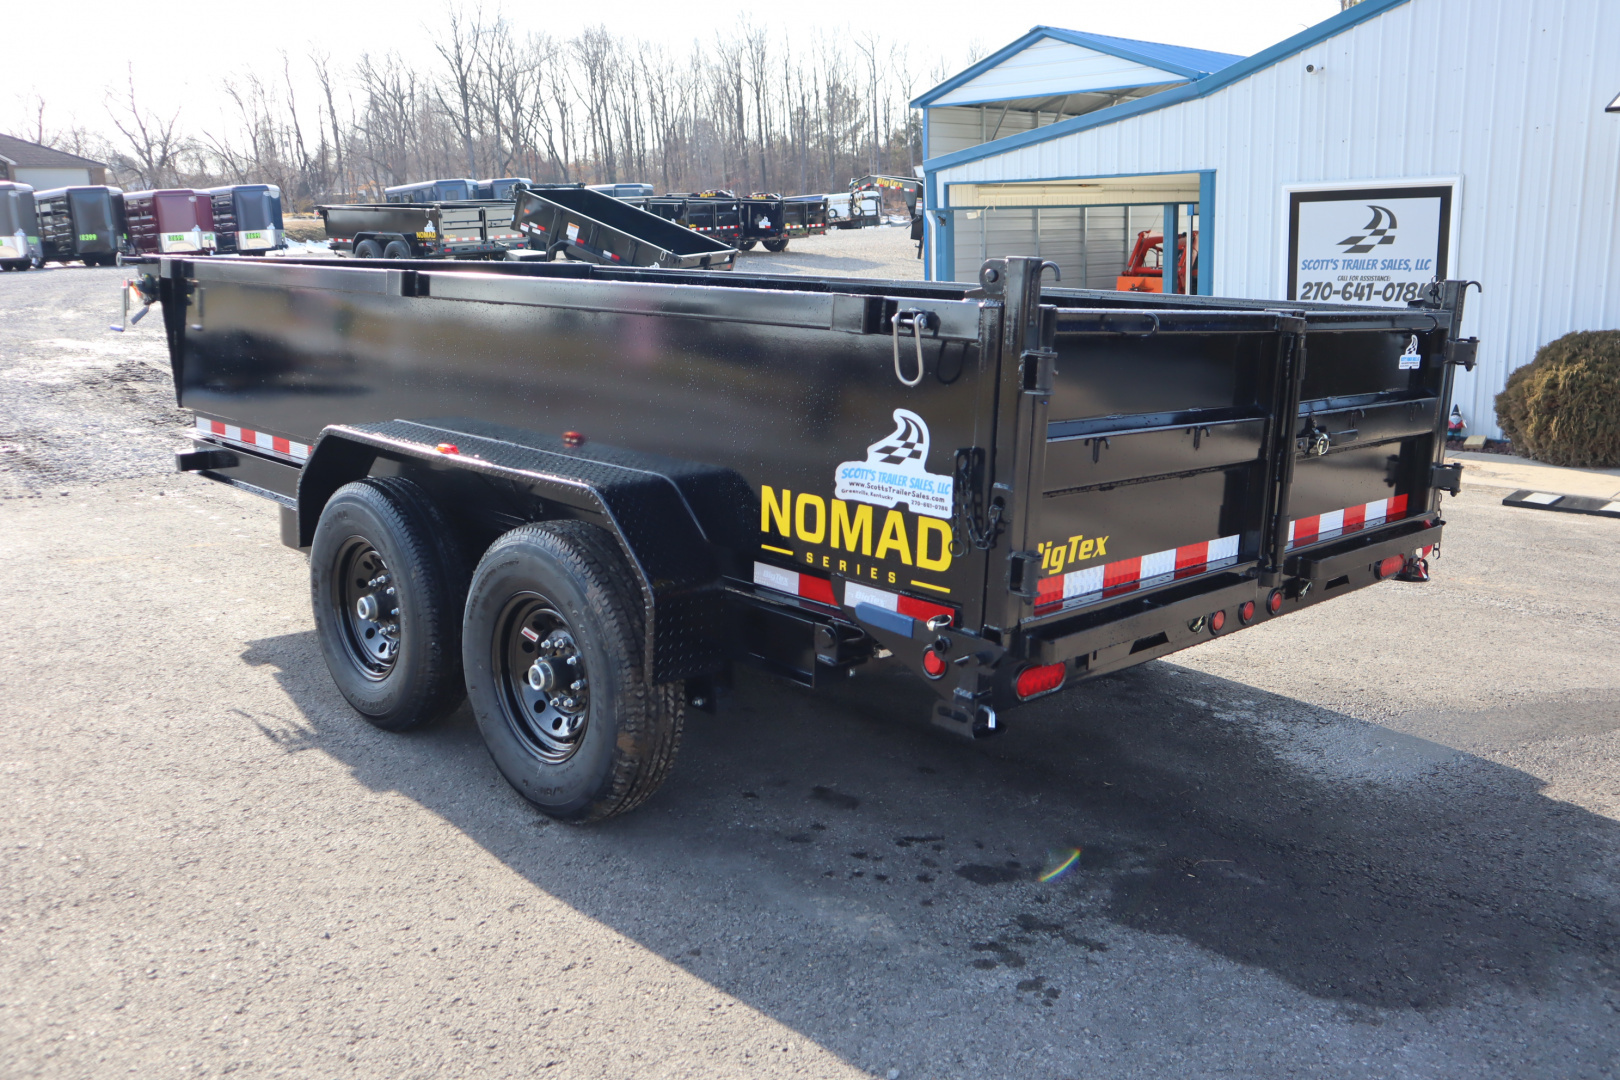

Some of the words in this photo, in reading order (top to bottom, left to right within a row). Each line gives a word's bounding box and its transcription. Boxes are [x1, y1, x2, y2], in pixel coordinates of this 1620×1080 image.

[876, 178, 903, 188] BigTex
[416, 231, 437, 239] NOMAD
[1301, 258, 1339, 271] SCOTT'S
[1341, 258, 1378, 271] TRAILER
[1380, 258, 1412, 272] SALES,
[1414, 258, 1431, 271] LLC
[841, 467, 877, 482] SCOTT'S
[878, 471, 907, 487] TRAILER
[909, 477, 935, 494] SALES,
[937, 482, 951, 495] LLC
[841, 488, 870, 497] Greenville,
[870, 491, 894, 501] Kentucky
[848, 481, 945, 503] www.ScottsTrailerSales.com
[760, 484, 953, 572] NOMAD
[806, 551, 896, 584] SERIES
